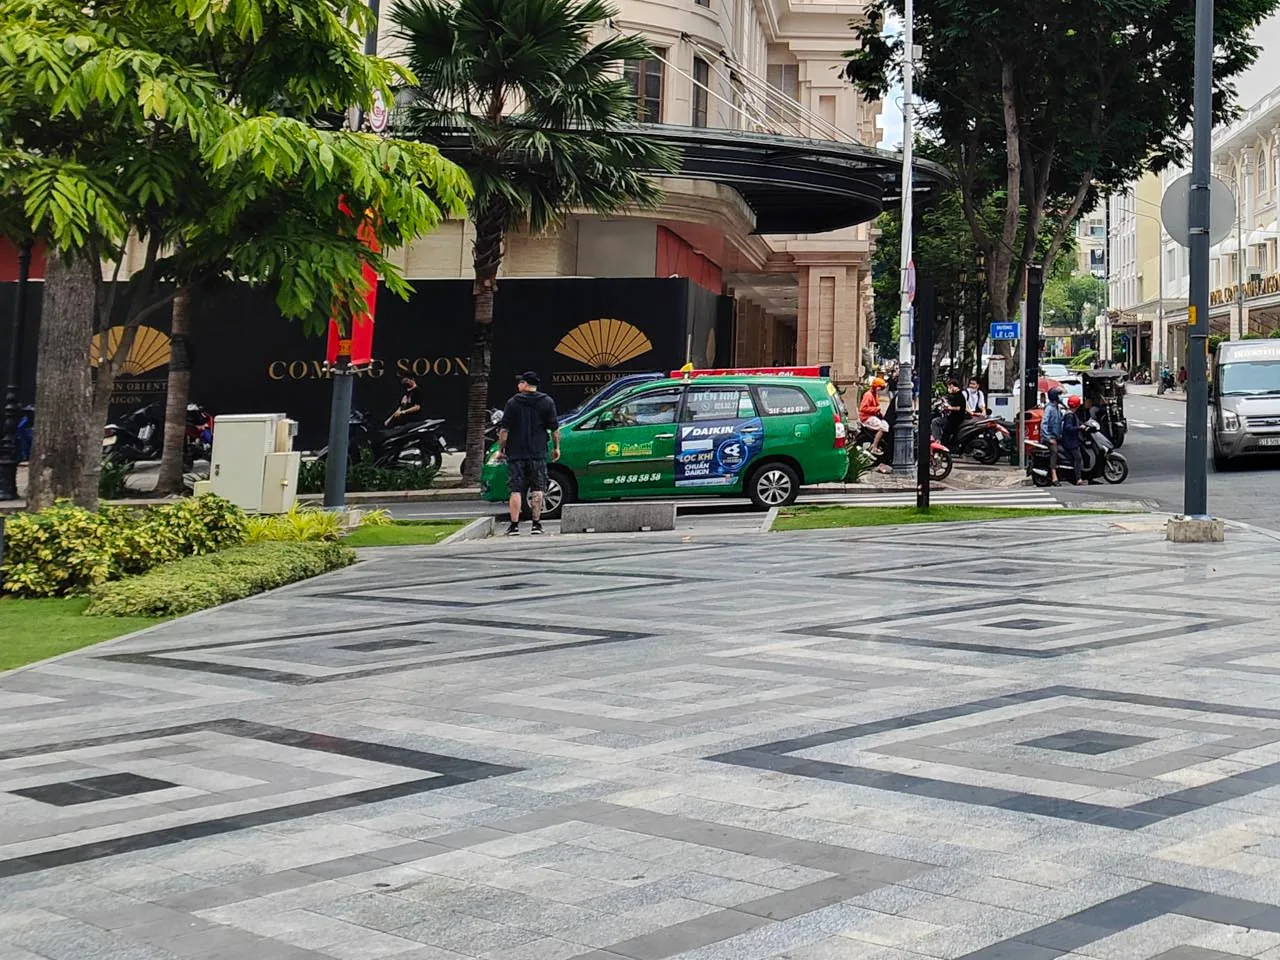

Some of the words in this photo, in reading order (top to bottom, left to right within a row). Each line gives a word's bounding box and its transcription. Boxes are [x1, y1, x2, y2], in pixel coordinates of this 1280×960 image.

[267, 359, 385, 380] COMNG
[395, 356, 472, 377] SOON
[126, 382, 168, 390] ORIENT
[692, 425, 734, 436] DAIKIN
[684, 468, 710, 477] DAIKIN
